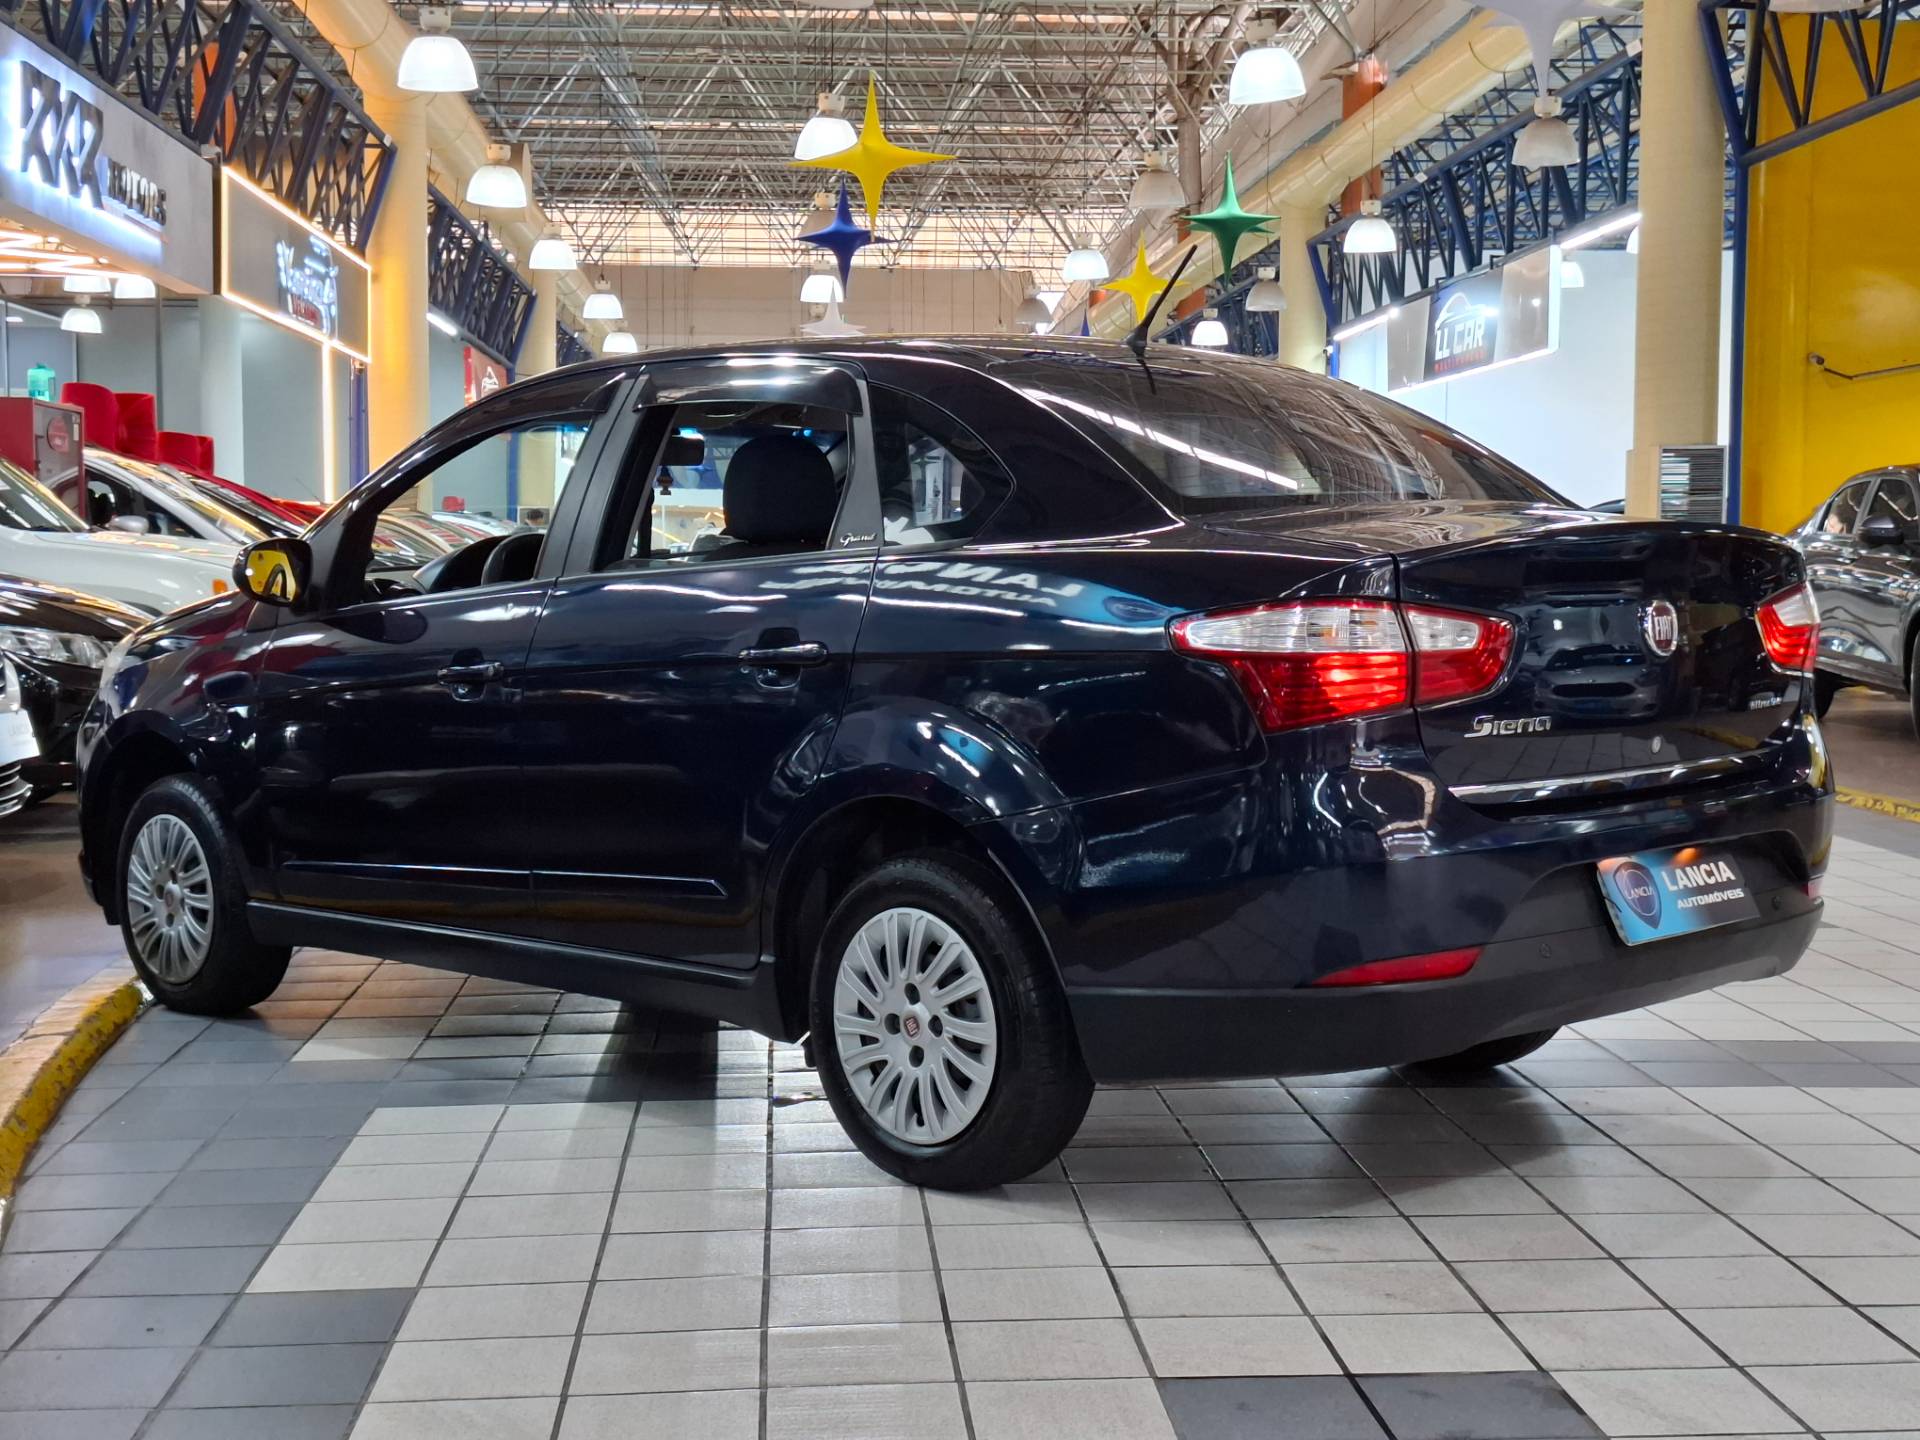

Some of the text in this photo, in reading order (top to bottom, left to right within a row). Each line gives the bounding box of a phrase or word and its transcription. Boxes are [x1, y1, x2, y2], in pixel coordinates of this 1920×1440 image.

[108, 158, 167, 226] MOTORS
[1453, 319, 1486, 354] CAR
[840, 532, 877, 547] Grand
[1654, 615, 1674, 641] FIAT
[1463, 714, 1552, 738] Siena
[1661, 861, 1736, 891] LANCIA
[1624, 884, 1654, 899] LANCIA
[1677, 887, 1745, 909] AUTOMÓVEIS
